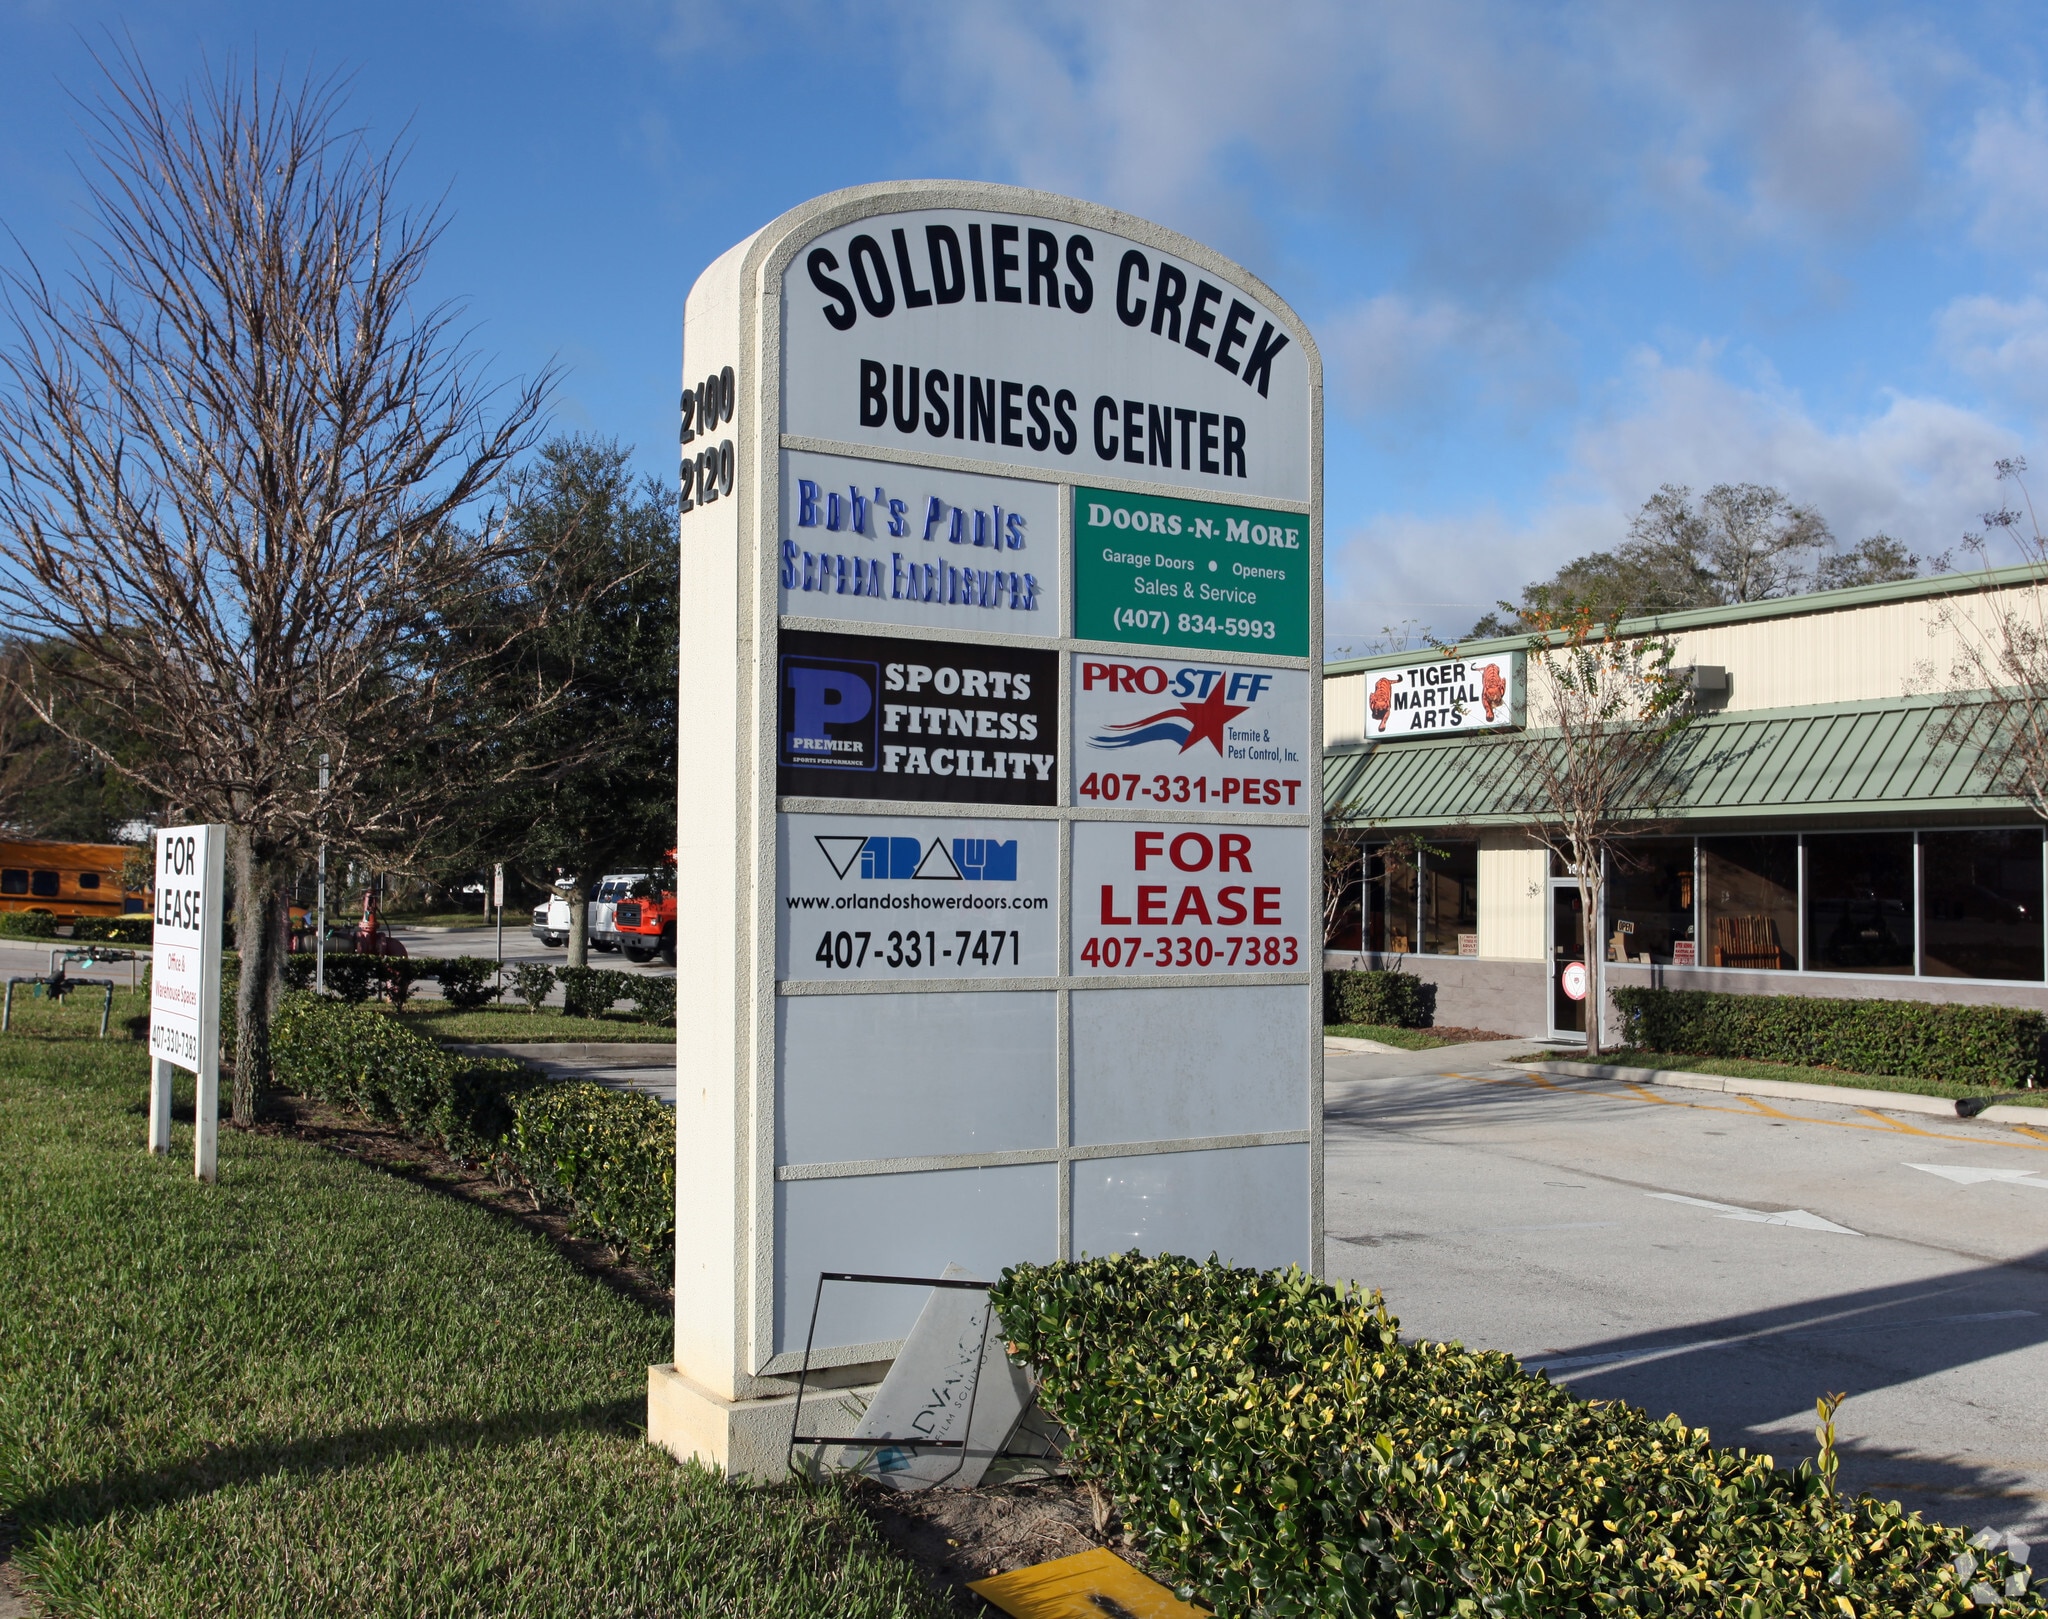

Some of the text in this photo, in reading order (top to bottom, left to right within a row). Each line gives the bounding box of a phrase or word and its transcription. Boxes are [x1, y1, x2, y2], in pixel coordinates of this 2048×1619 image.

[806, 223, 1290, 399] SOLDIERS CREEK
[680, 366, 735, 444] 2100
[860, 359, 1247, 478] BUSINESS CENTER
[679, 439, 734, 514] 2120
[798, 479, 1023, 550] Bob's Pools
[1088, 503, 1300, 550] DOORS -N- MORE
[782, 540, 879, 597] Screen
[1102, 548, 1286, 581] Garage Doors Openers
[1134, 577, 1257, 605] Sales & Service
[1113, 607, 1276, 639] (407) 834-5993
[884, 663, 1031, 701] SPORTS
[1407, 663, 1466, 688] TIGER
[1394, 684, 1479, 711] MARTIAL
[883, 704, 1038, 741] FITNESS
[1228, 727, 1271, 743] Termite &
[1410, 707, 1463, 730] ARTS
[793, 737, 864, 753] PREMIER
[793, 756, 864, 767] SPORTS PERFORMANCE
[882, 745, 1055, 781] FACILITY
[1228, 745, 1299, 763] Pest Control, Inc.
[1079, 772, 1302, 806] 407-331-PEST
[165, 836, 195, 876] FOR
[1134, 831, 1253, 873] FOR
[156, 888, 200, 931] LEASE
[786, 892, 1048, 910] www.orlandoshowerdoors.com
[1101, 885, 1282, 926] LEASE
[1618, 921, 1633, 933] OPEN
[168, 953, 181, 972] Office
[815, 930, 1020, 969] 407-331-7471
[1081, 936, 1299, 968] 407-330-7383
[156, 980, 197, 1007] Warehouse Spaces
[152, 1024, 197, 1062] 407-330-7383
[935, 1403, 955, 1442] FILM
